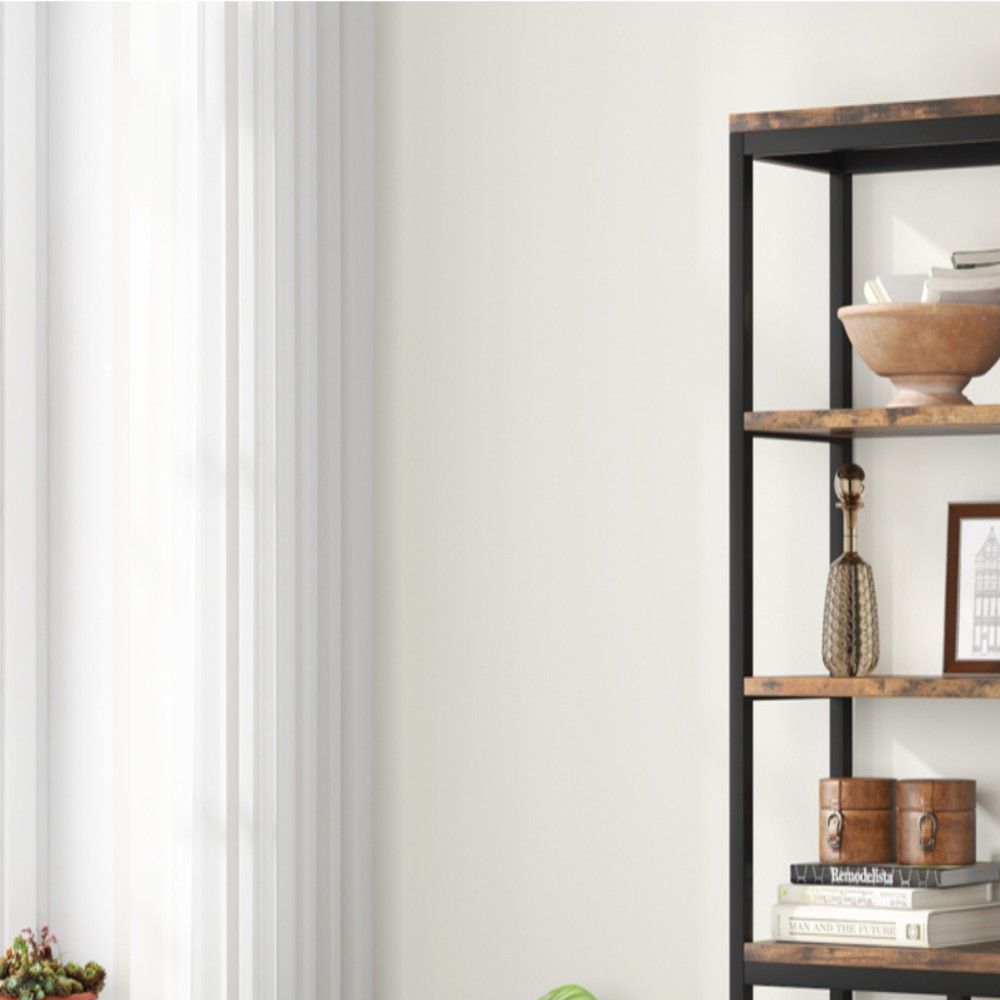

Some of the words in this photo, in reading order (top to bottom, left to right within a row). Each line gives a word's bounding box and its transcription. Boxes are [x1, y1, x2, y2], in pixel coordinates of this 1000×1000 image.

[830, 867, 895, 885] Remodelista
[789, 920, 812, 932] MAN
[813, 921, 834, 933] AND
[835, 923, 857, 935] THE
[858, 924, 897, 937] FUTURE
